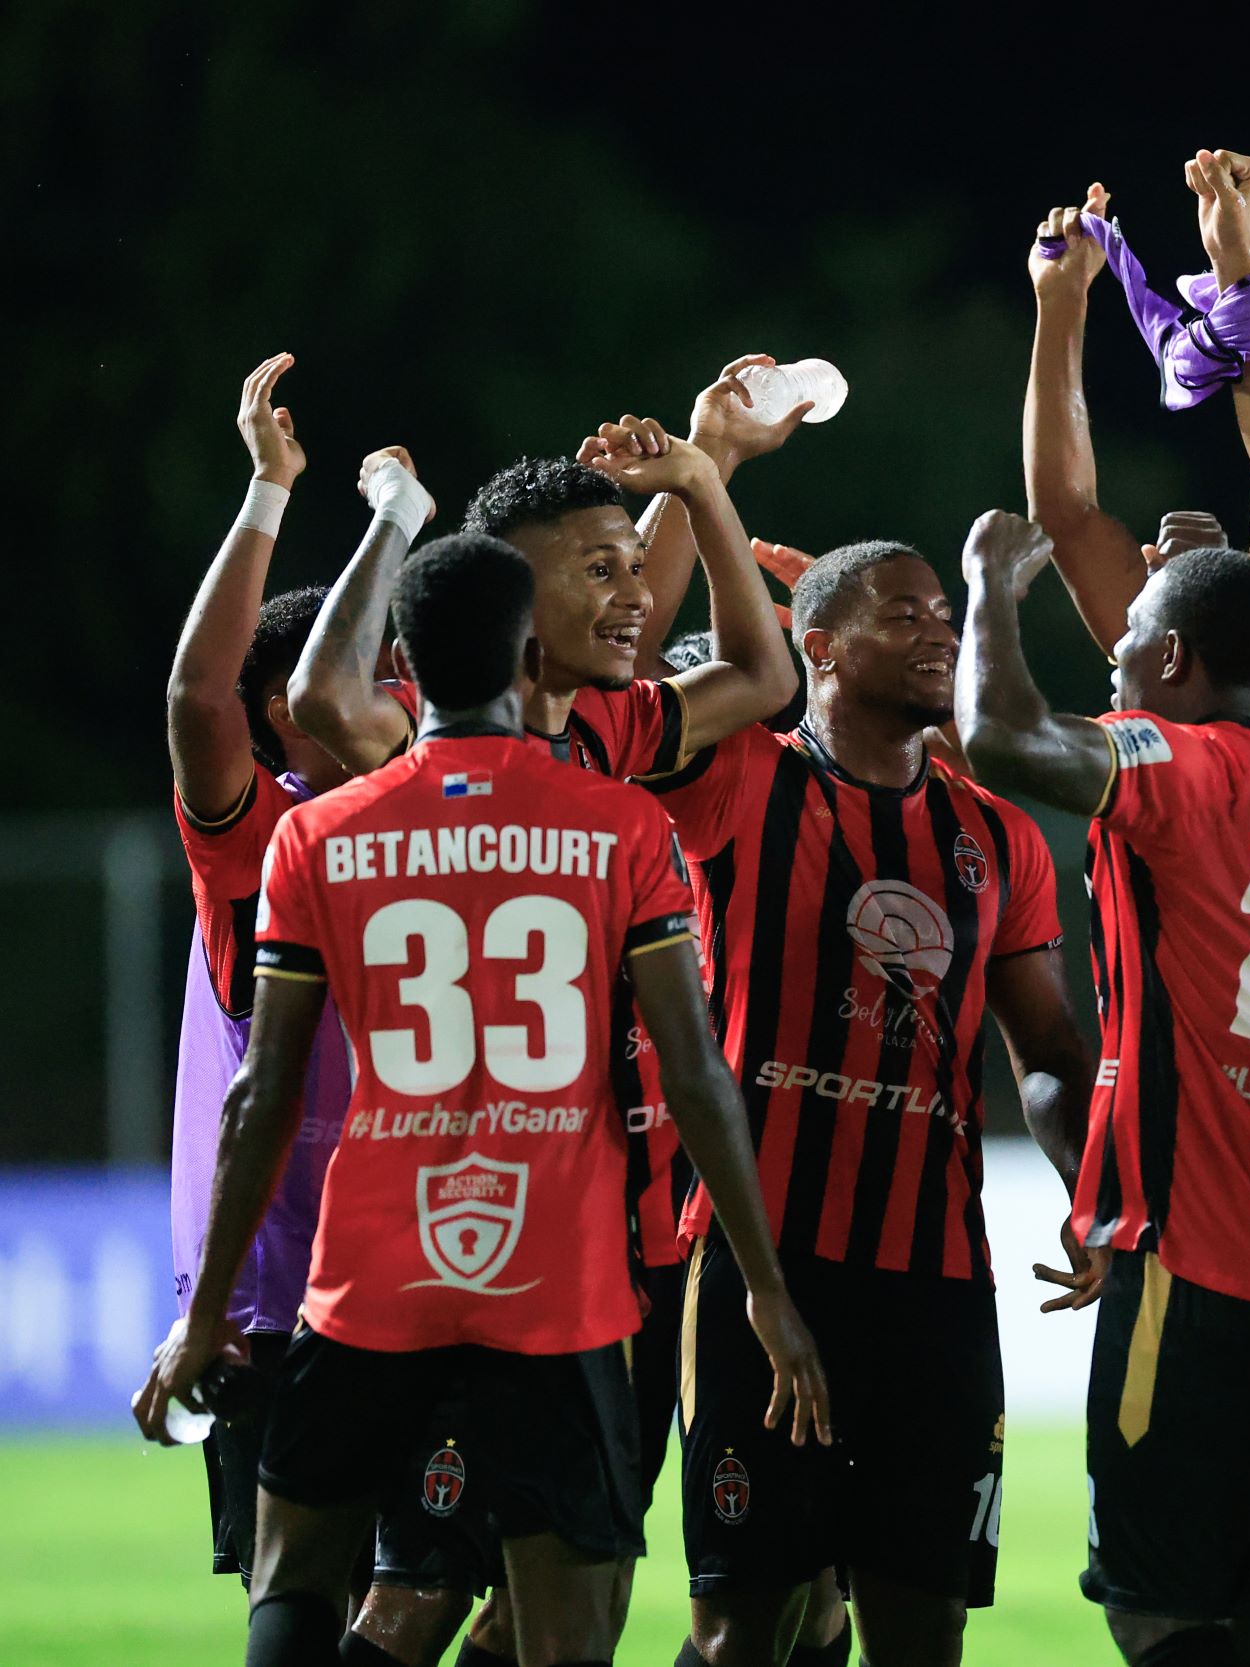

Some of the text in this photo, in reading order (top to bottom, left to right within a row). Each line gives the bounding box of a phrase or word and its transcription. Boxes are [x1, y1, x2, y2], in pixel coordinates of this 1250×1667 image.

[325, 824, 618, 884] BETANCOURT
[362, 895, 589, 1096] 33
[838, 987, 886, 1028] Sol
[349, 1101, 588, 1141] #LucharYGanar
[438, 1184, 507, 1200] SECURITY
[446, 1174, 498, 1190] ACTION
